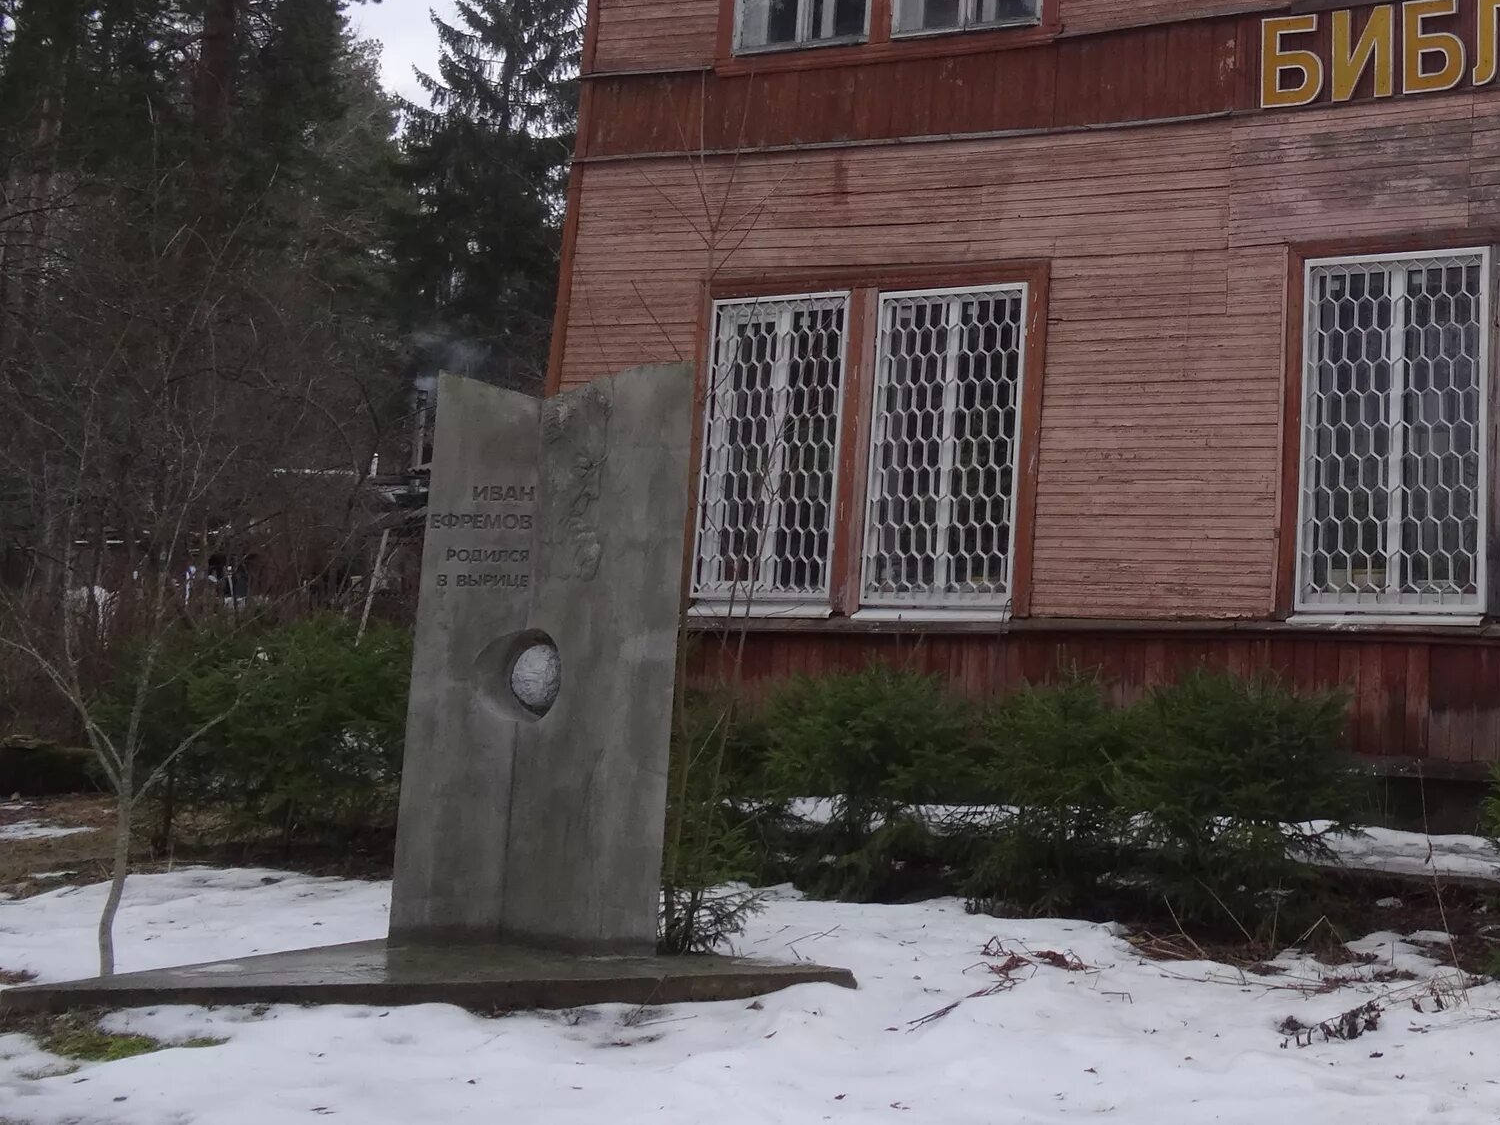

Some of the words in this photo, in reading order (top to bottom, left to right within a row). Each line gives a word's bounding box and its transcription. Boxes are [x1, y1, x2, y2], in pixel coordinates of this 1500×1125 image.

[472, 485, 535, 502] ИВАН
[429, 513, 533, 530] ЕФРЕМОВ
[445, 548, 530, 564] РОДИЛСЯ
[437, 575, 448, 587] В
[456, 574, 529, 588] ВЫРИЦЕ
